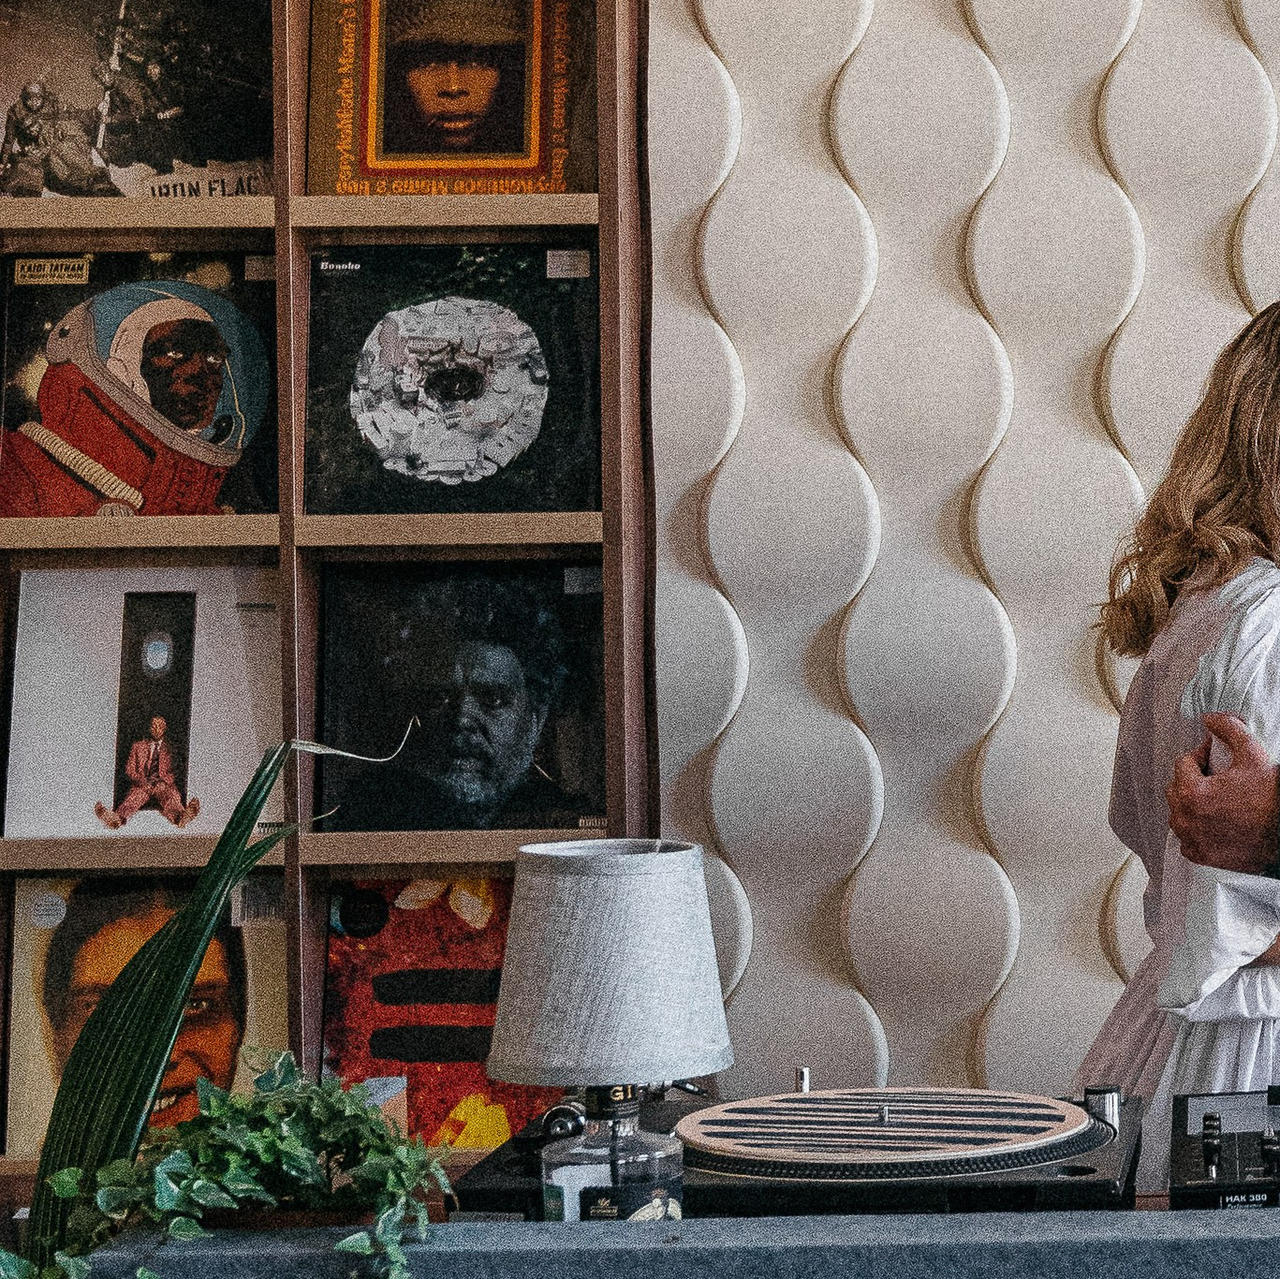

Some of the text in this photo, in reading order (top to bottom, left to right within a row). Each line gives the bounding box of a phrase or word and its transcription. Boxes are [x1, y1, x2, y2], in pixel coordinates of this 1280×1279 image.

[150, 181, 200, 197] IRON
[320, 261, 361, 271] Bonobo
[1226, 1195, 1247, 1203] HAK
